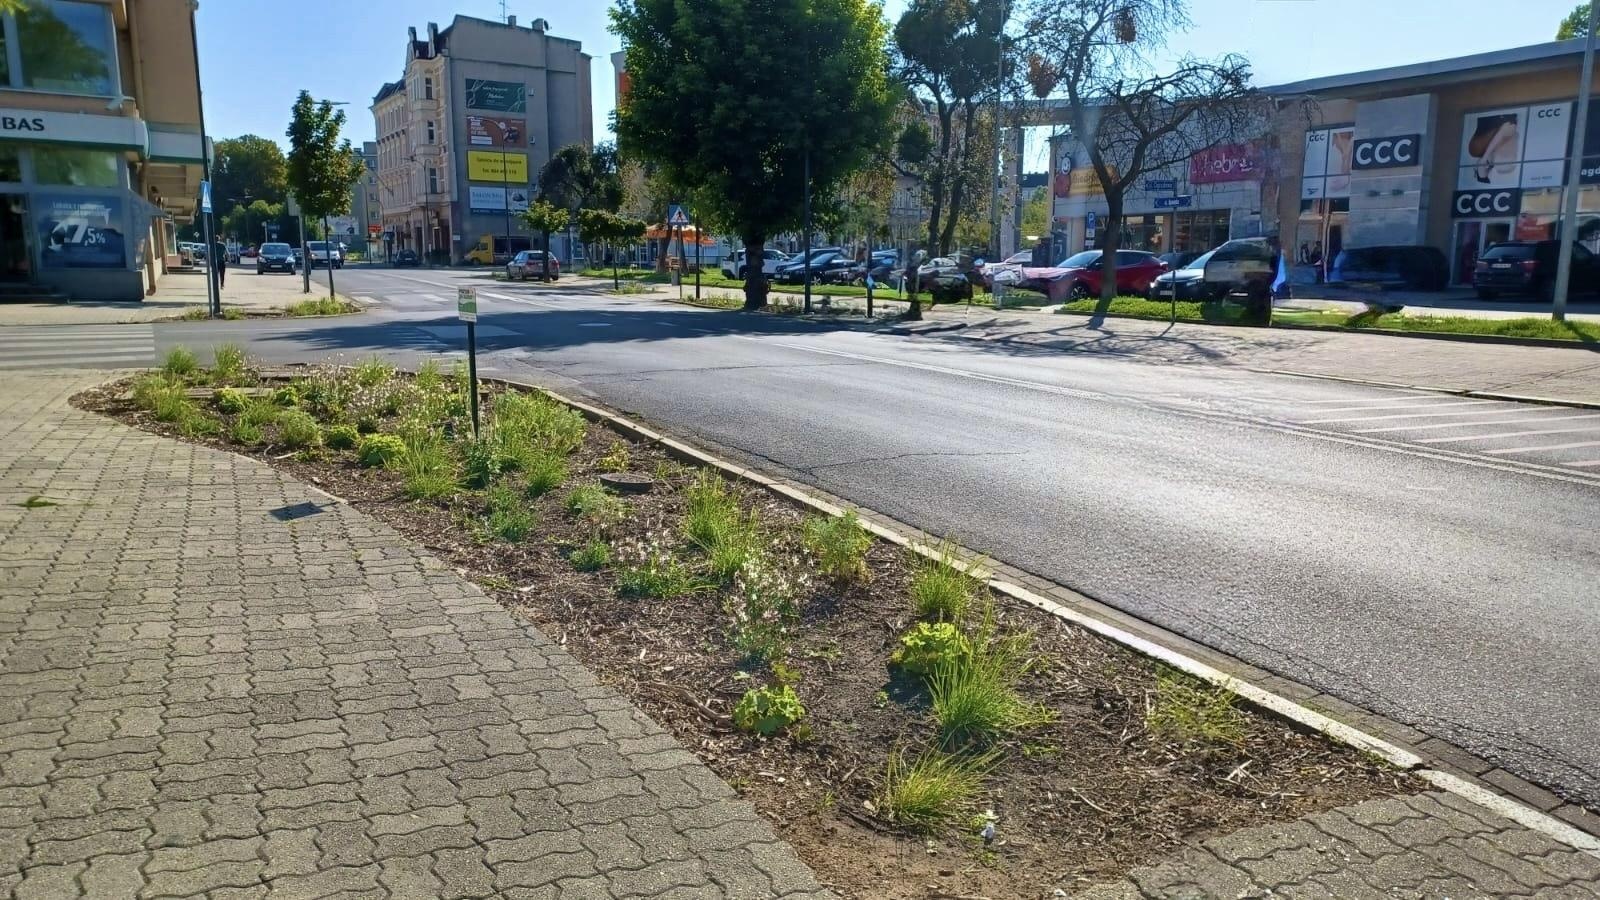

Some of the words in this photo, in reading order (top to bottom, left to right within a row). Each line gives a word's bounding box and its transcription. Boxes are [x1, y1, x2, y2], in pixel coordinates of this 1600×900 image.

[1537, 108, 1561, 119] CCC
[2, 116, 45, 131] BAS
[1309, 134, 1326, 142] CCC
[1355, 138, 1412, 165] CCC
[1456, 191, 1512, 214] CCC
